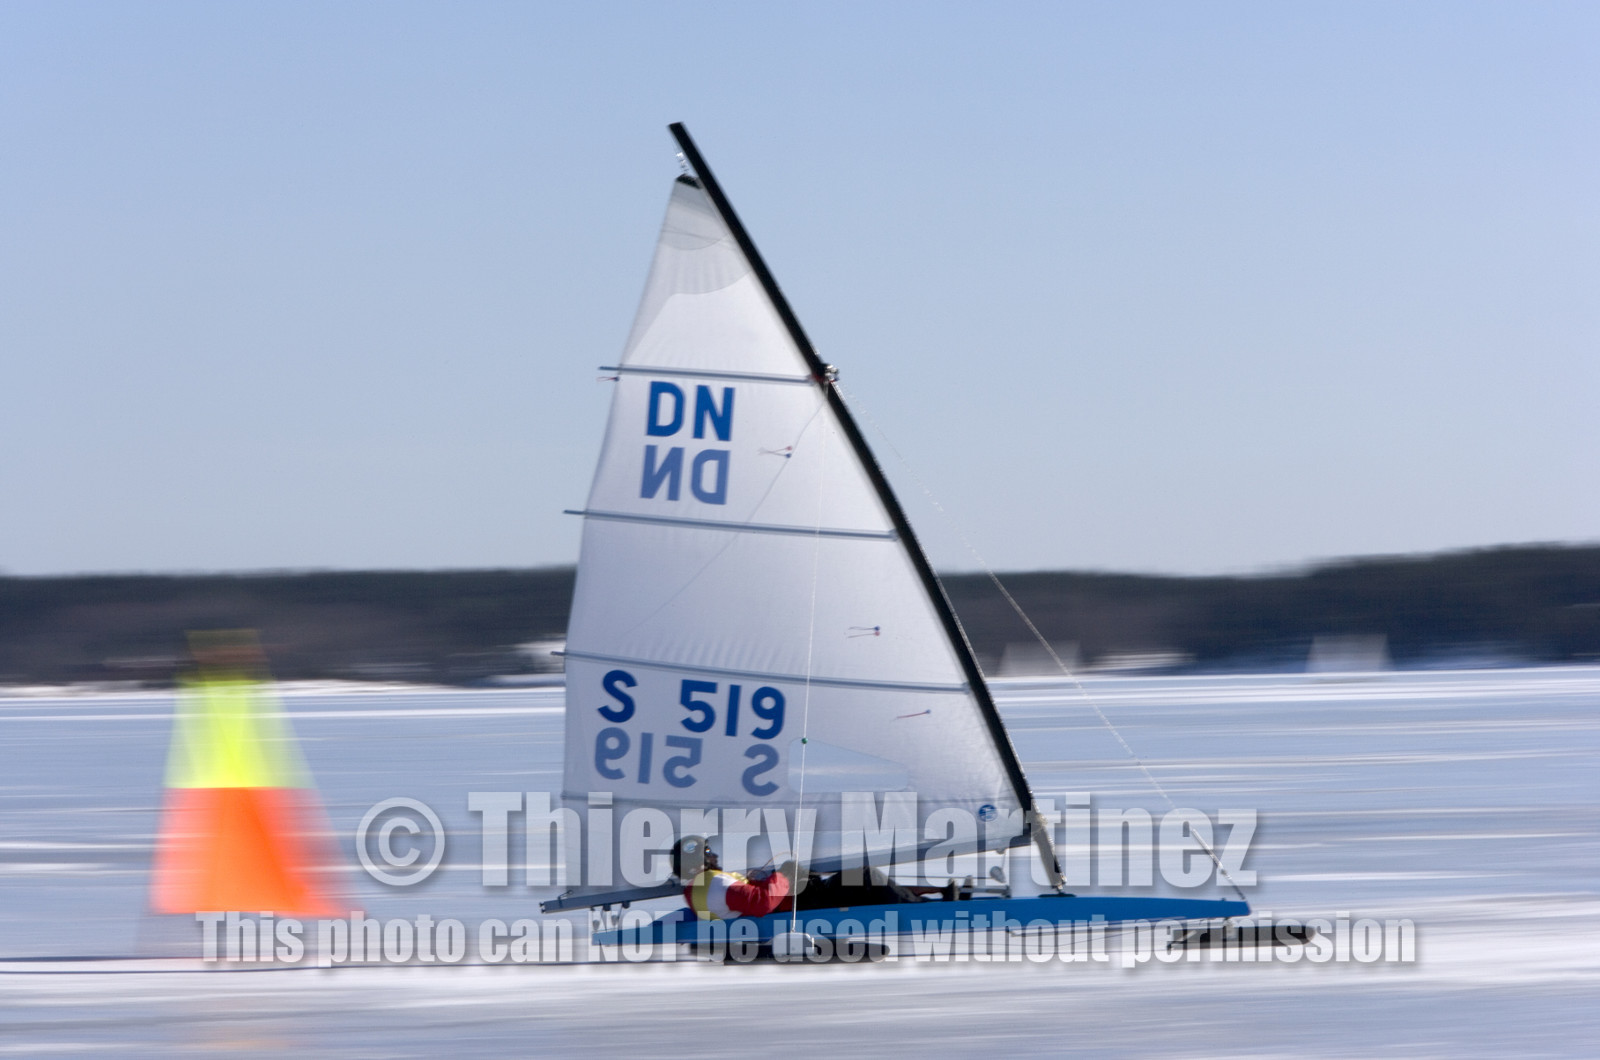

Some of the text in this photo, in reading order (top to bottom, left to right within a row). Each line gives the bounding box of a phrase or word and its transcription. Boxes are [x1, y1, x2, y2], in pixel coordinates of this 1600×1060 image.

[646, 381, 735, 442] DN
[598, 670, 786, 740] S 519
